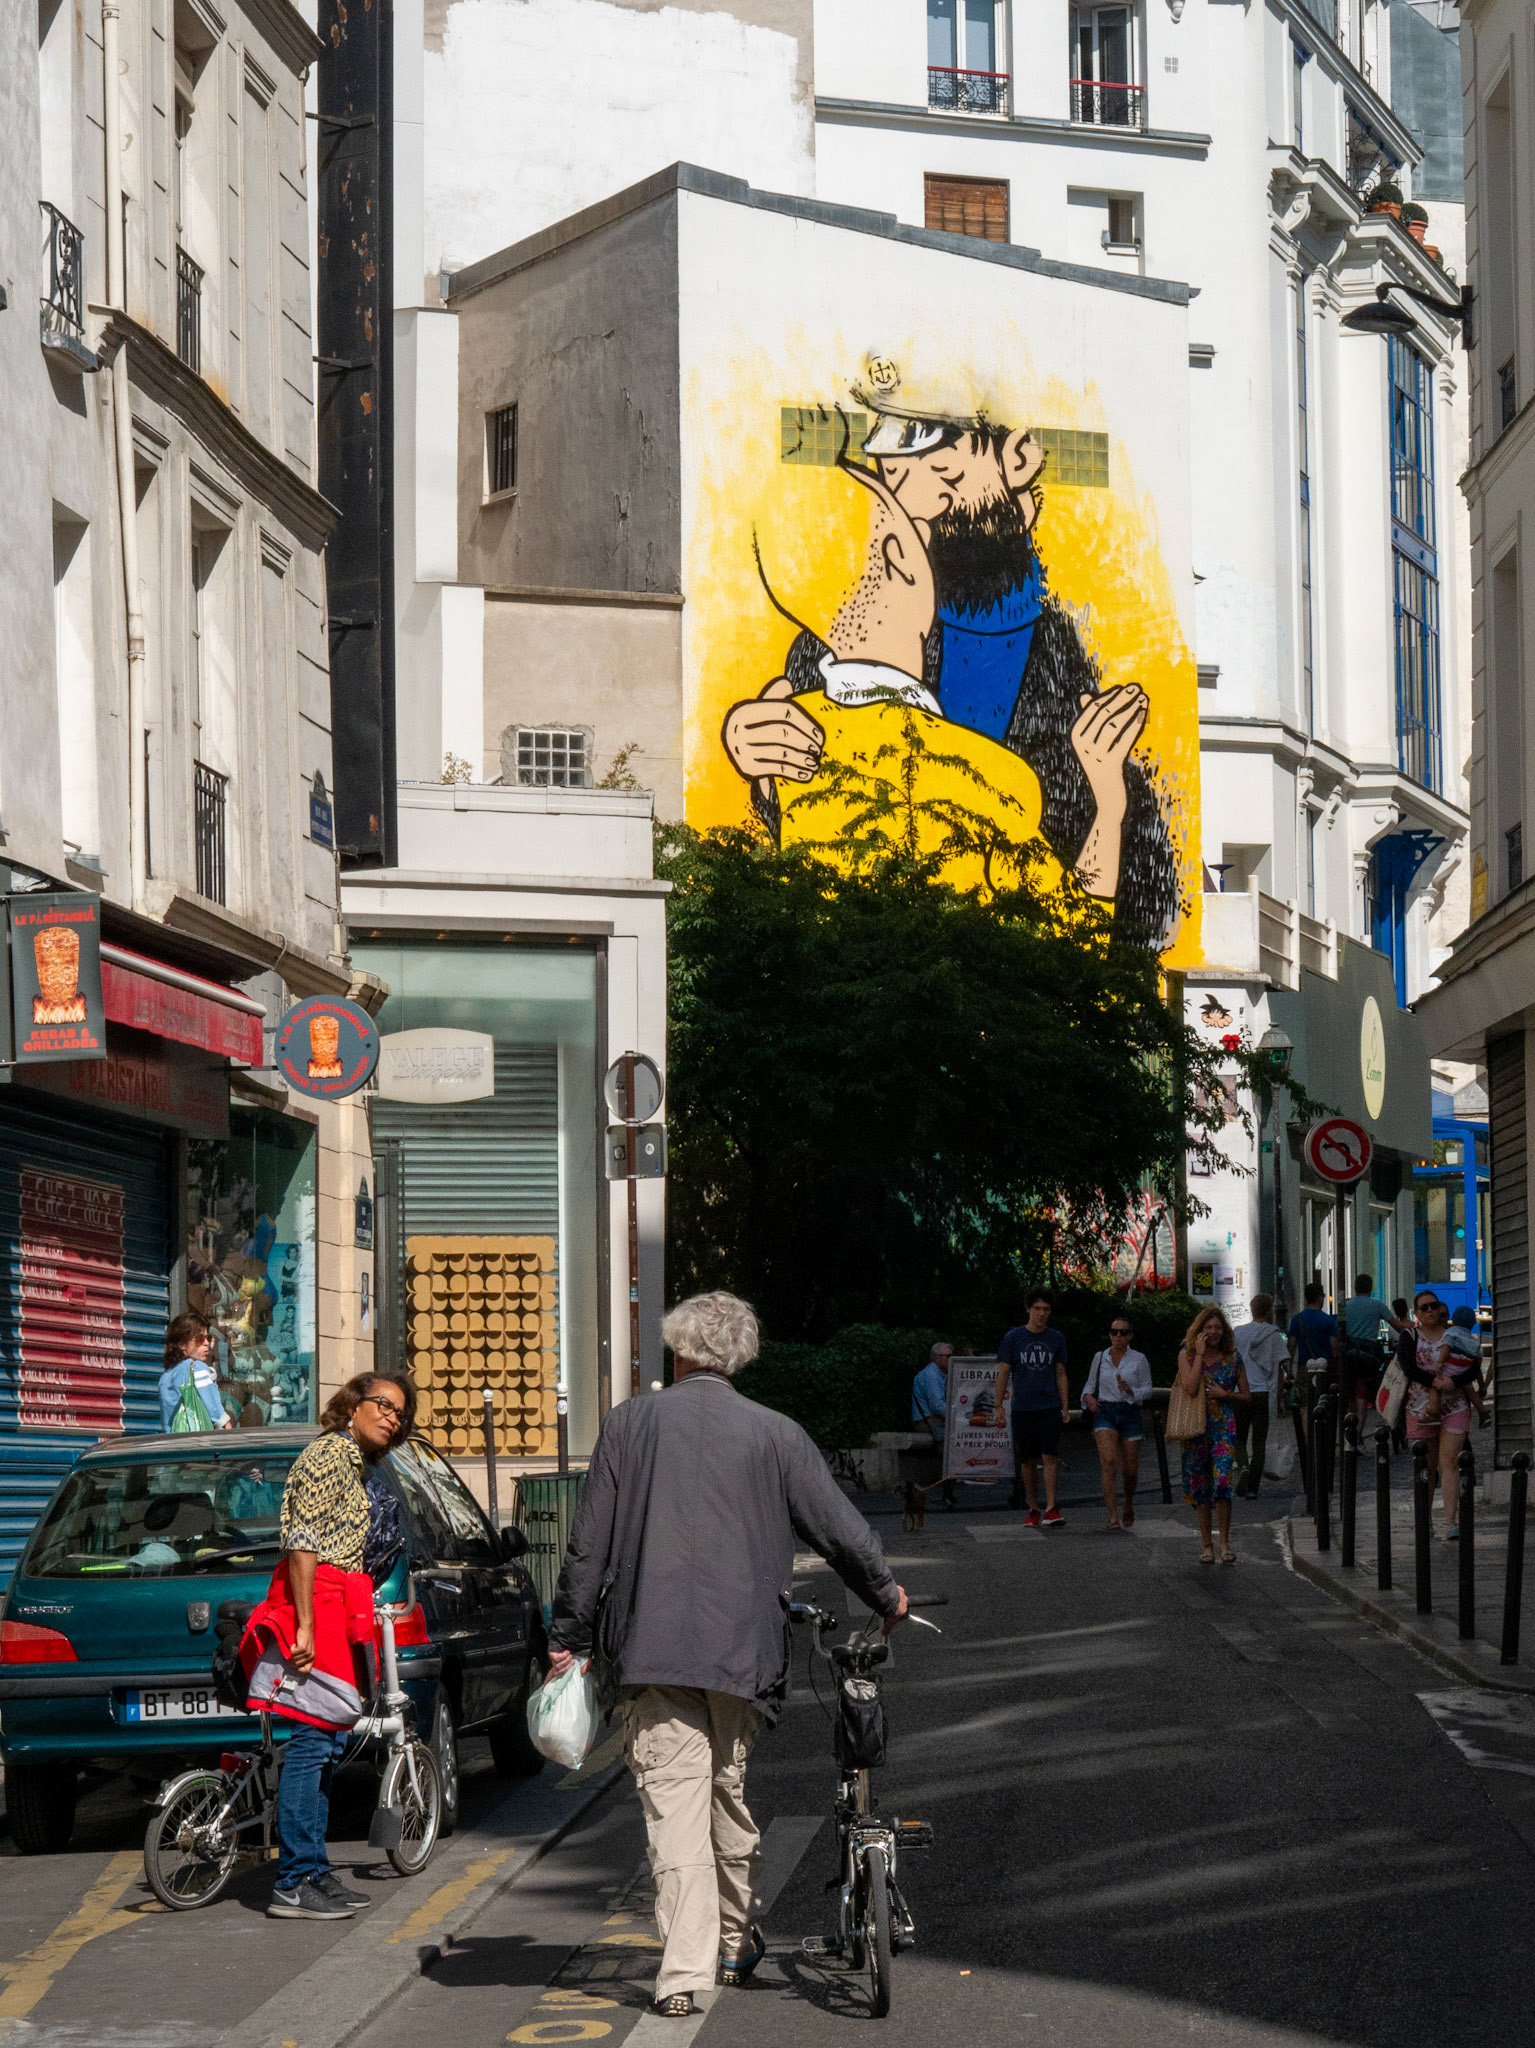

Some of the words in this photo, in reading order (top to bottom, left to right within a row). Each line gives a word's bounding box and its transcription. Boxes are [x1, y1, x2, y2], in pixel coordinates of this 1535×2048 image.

[15, 915, 27, 926] LE
[30, 1029, 76, 1041] KEBAB
[81, 1028, 90, 1038] &
[280, 1024, 293, 1043] LE
[23, 1038, 98, 1052] GRILLADES
[282, 1058, 309, 1088] KEBAB
[321, 1056, 370, 1093] GRILLADES
[1020, 1351, 1054, 1365] NAVY
[957, 1431, 983, 1439] LIVRES
[985, 1431, 1009, 1439] NEUFS
[130, 1708, 136, 1716] F
